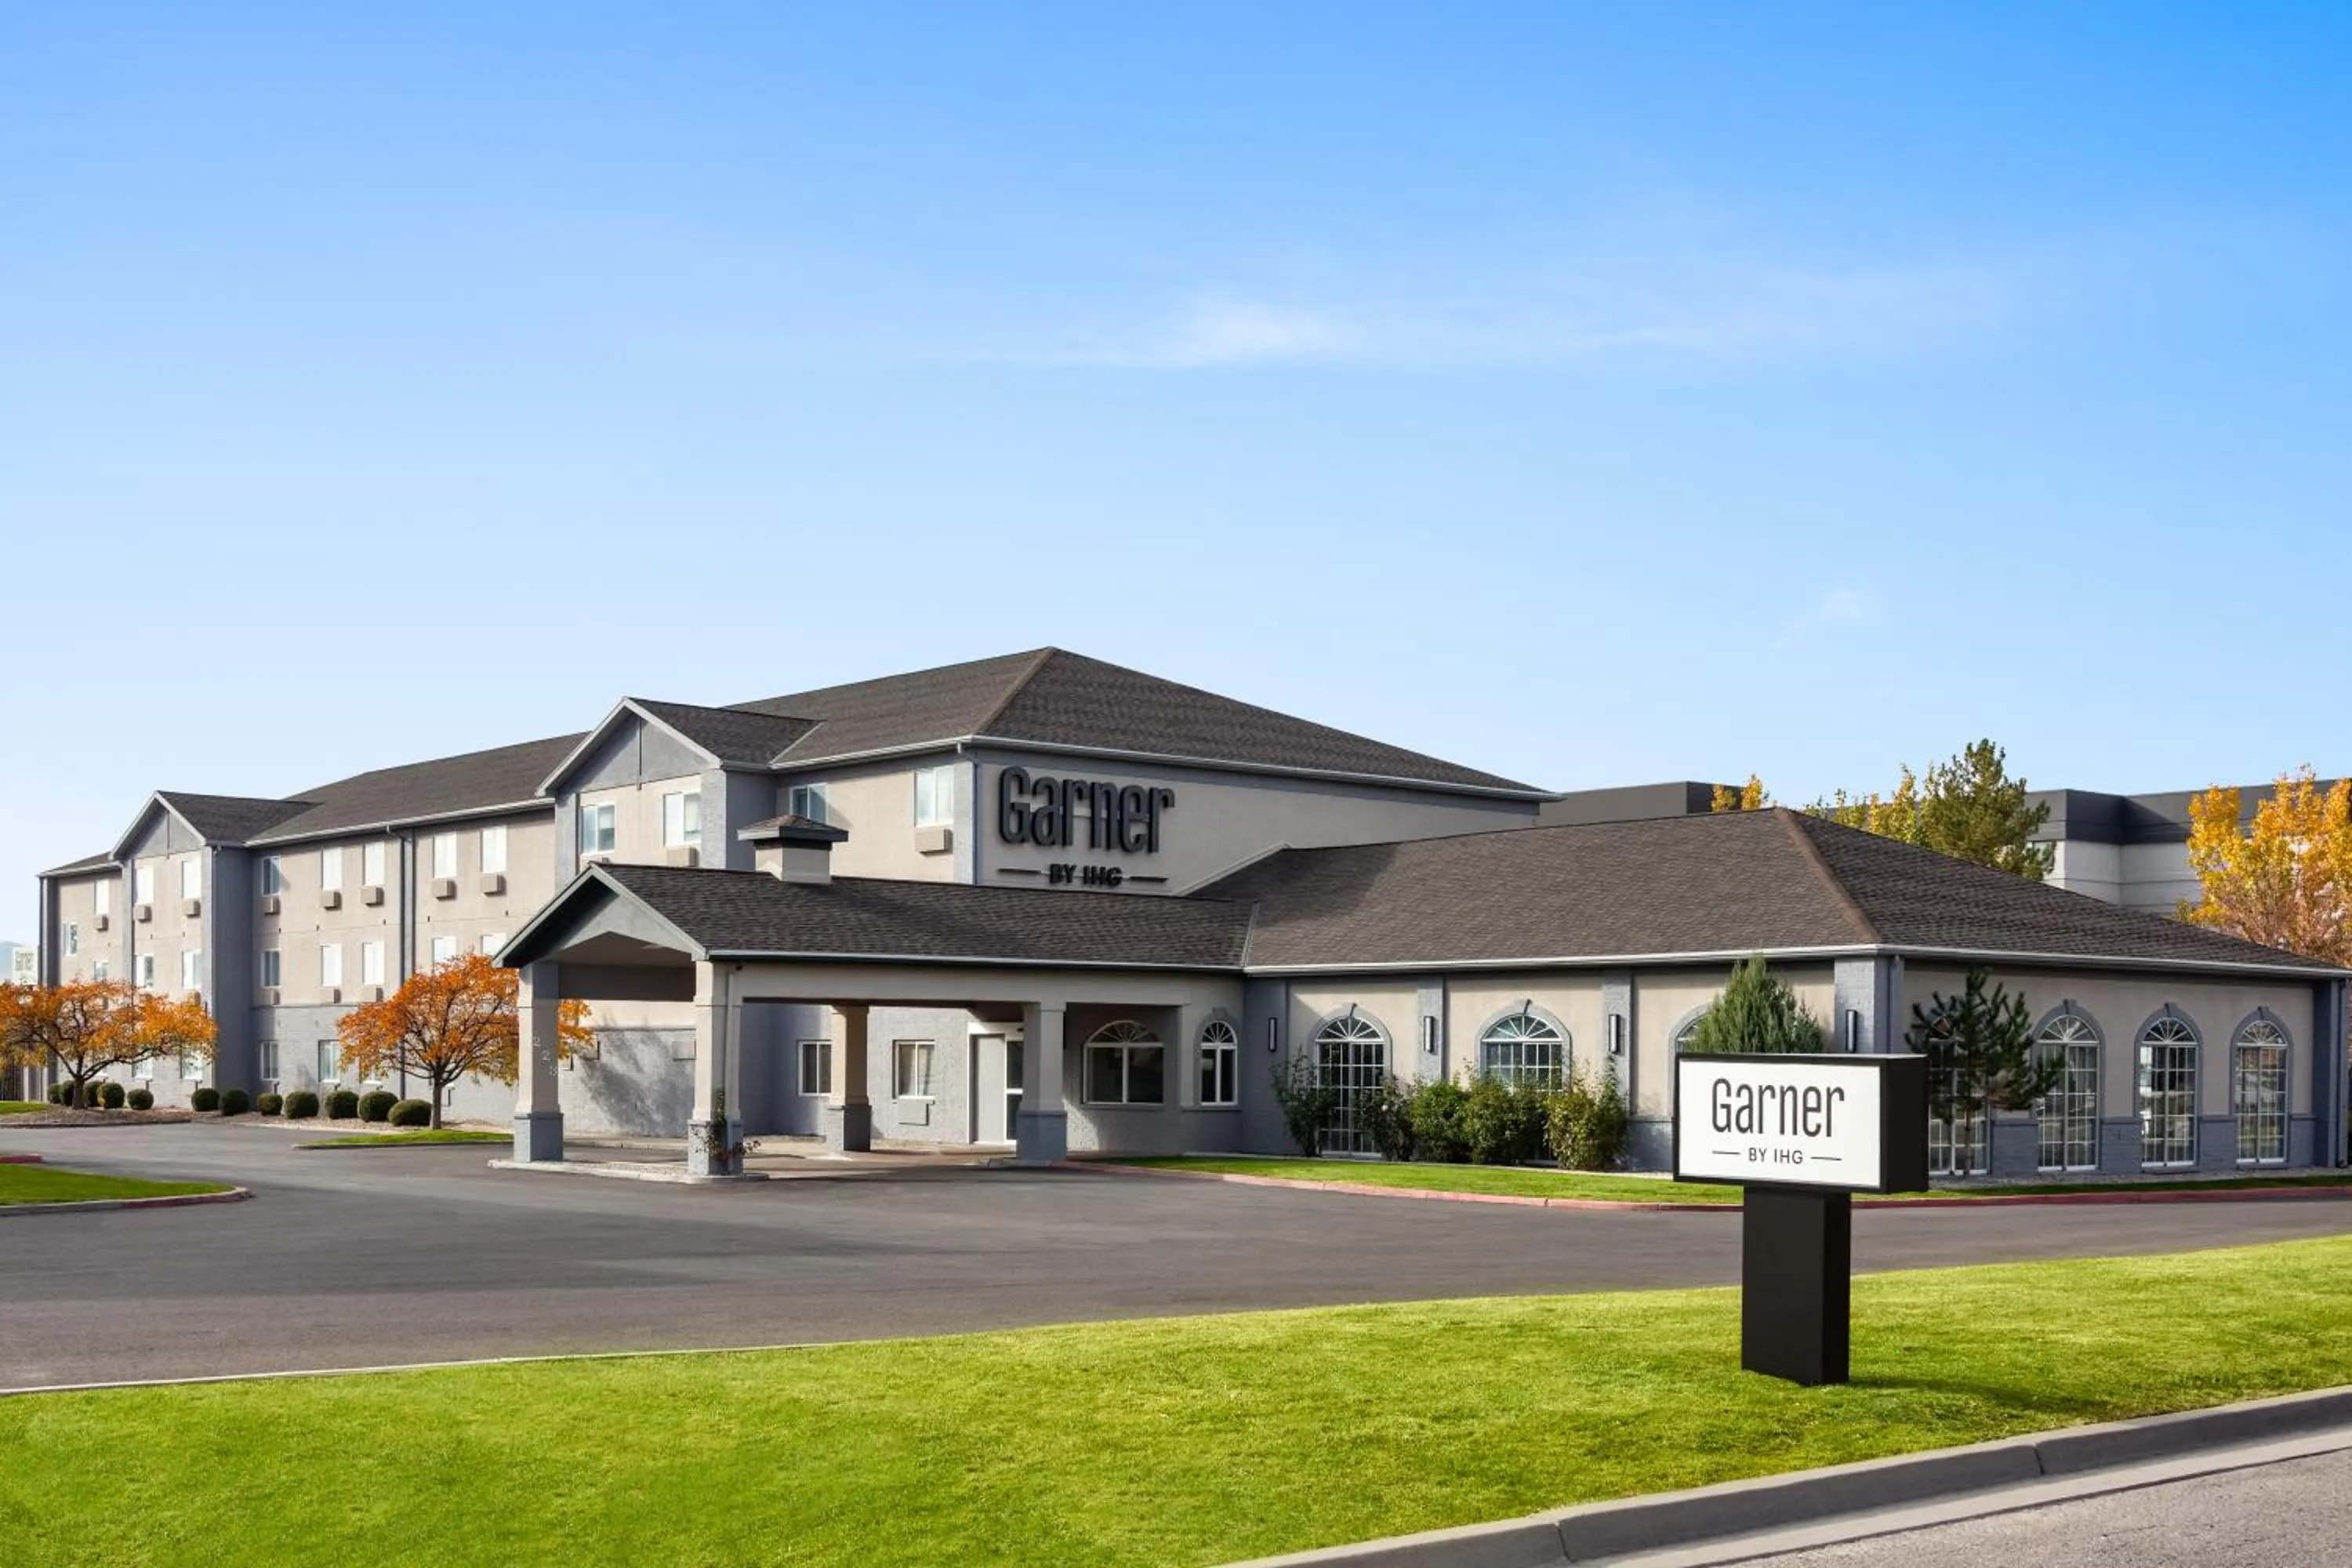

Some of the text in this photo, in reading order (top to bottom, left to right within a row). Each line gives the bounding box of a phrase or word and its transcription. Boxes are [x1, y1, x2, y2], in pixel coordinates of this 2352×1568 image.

[998, 765, 1175, 854] Garner
[1049, 863, 1123, 886] BY IHG
[1711, 1078, 1845, 1138] Garner
[1748, 1147, 1804, 1164] BY IHG
